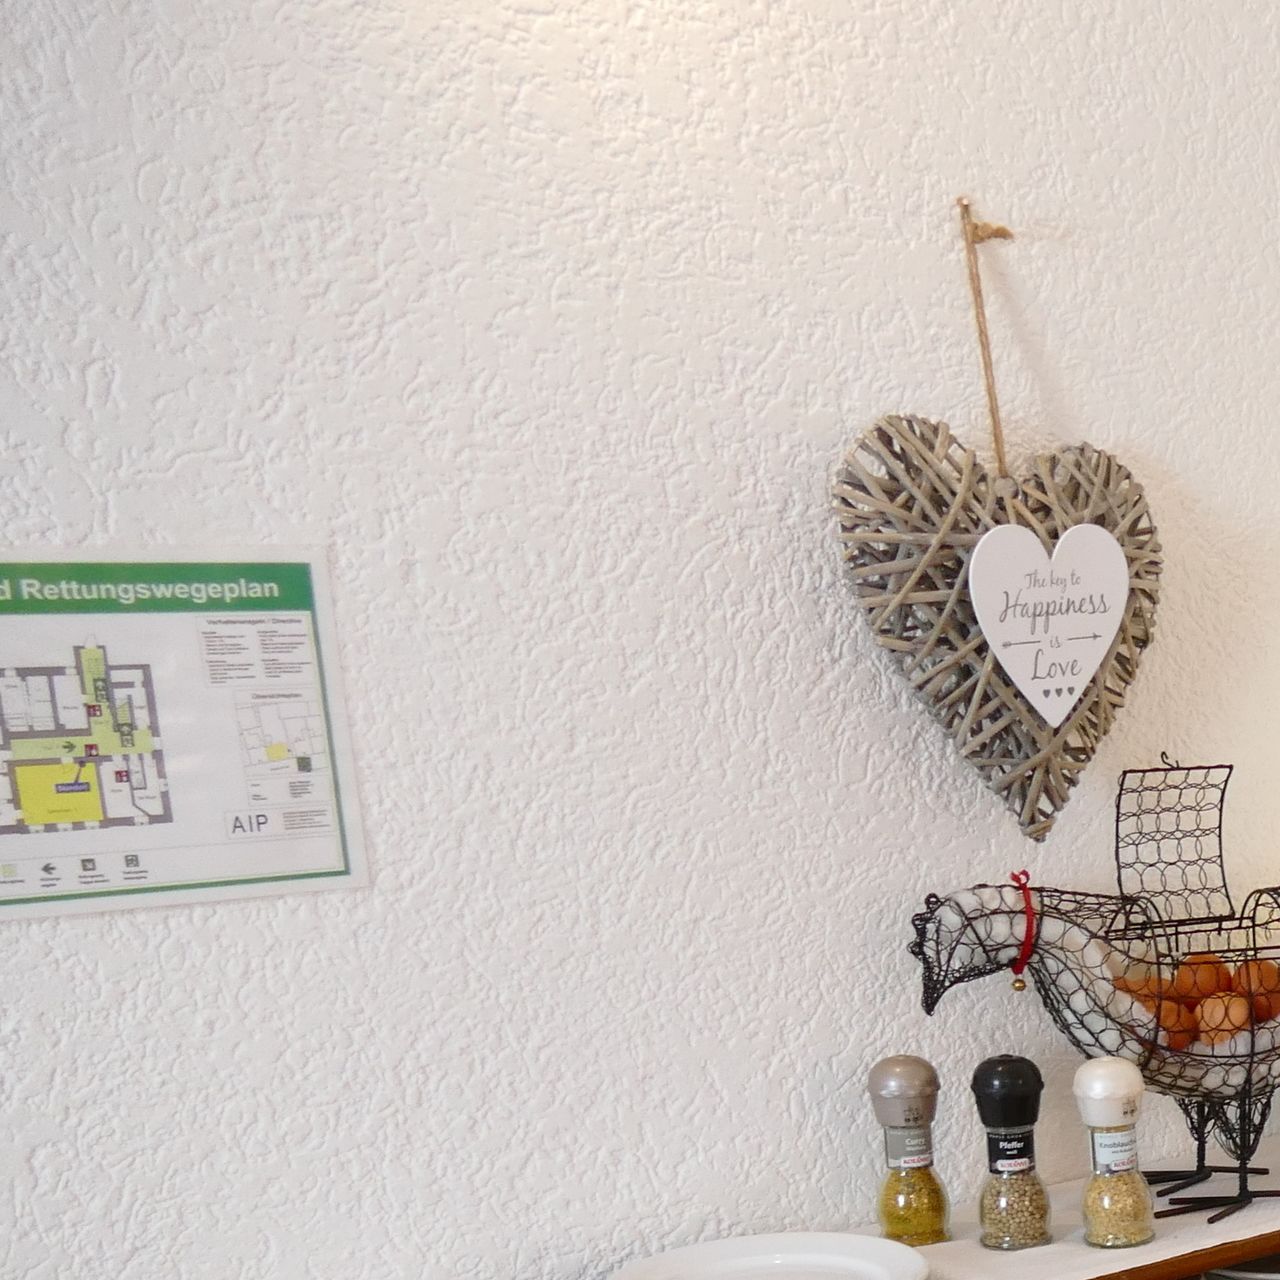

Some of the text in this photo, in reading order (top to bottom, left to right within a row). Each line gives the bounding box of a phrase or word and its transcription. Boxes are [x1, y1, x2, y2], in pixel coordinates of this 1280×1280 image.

[20, 578, 279, 603] Rettungswegeplan
[1023, 568, 1047, 590] The
[1050, 569, 1068, 592] key
[999, 588, 1112, 636] Happiness
[1031, 649, 1083, 681] Love
[232, 814, 269, 834] AIP
[999, 1141, 1024, 1149] Pfeffer
